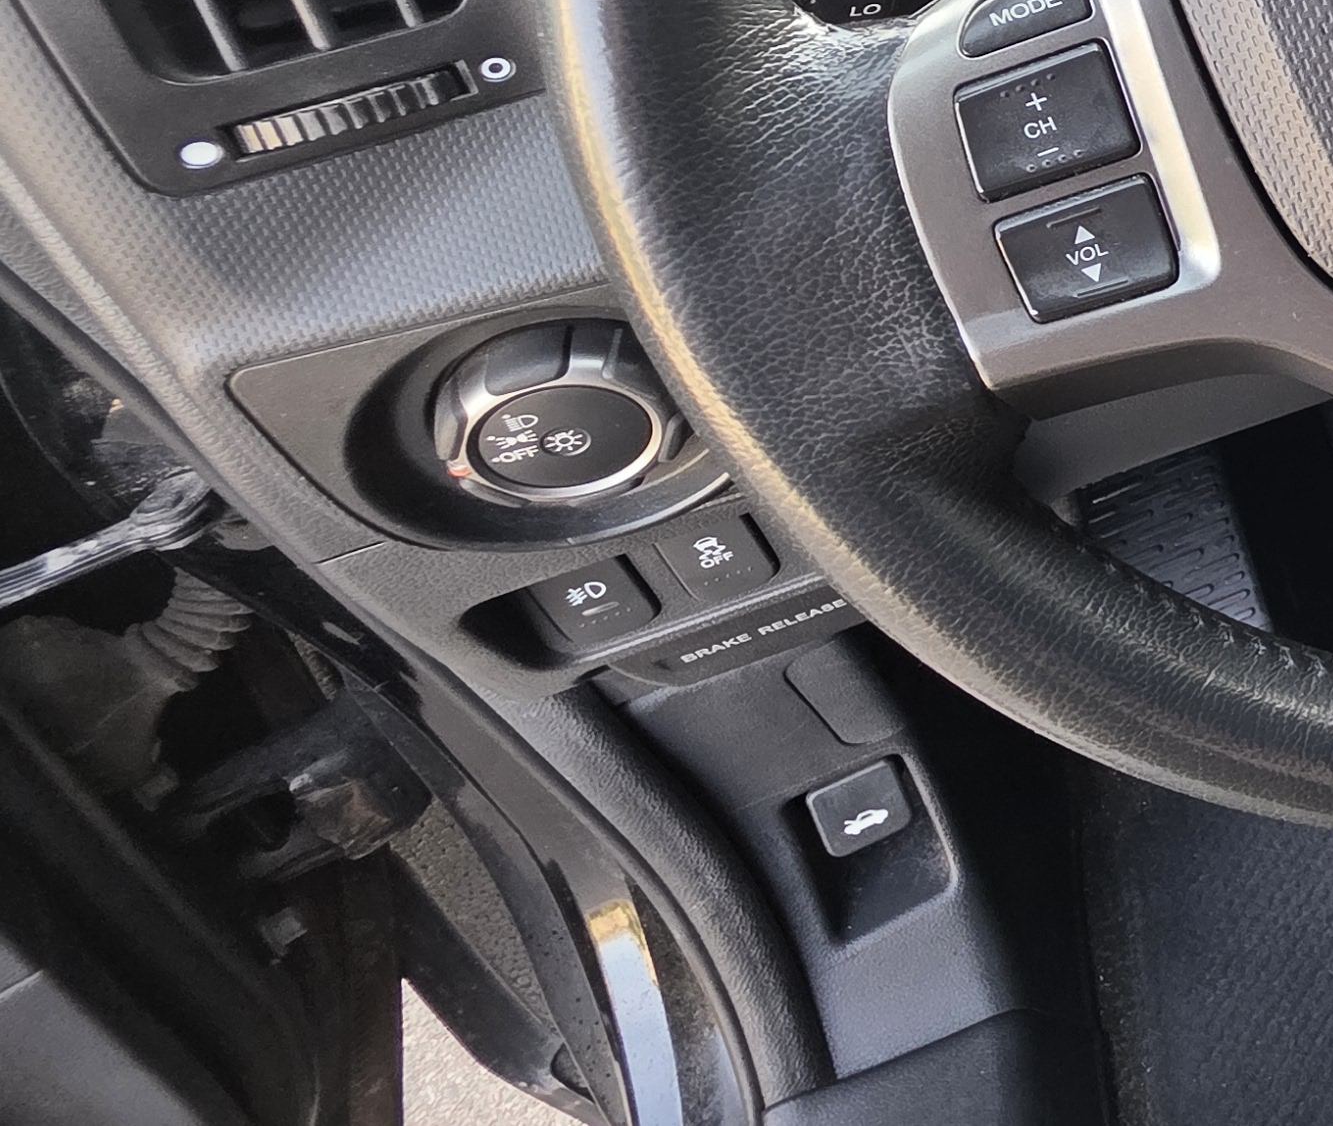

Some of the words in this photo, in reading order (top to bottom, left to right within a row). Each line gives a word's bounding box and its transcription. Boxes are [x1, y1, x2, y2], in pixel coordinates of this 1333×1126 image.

[848, 2, 882, 18] LO
[1023, 116, 1058, 140] CH
[1065, 242, 1109, 266] VOL
[499, 444, 539, 463] OFF
[700, 550, 734, 569] OFF
[680, 632, 753, 664] BRAKE
[757, 598, 848, 636] RELEASE
